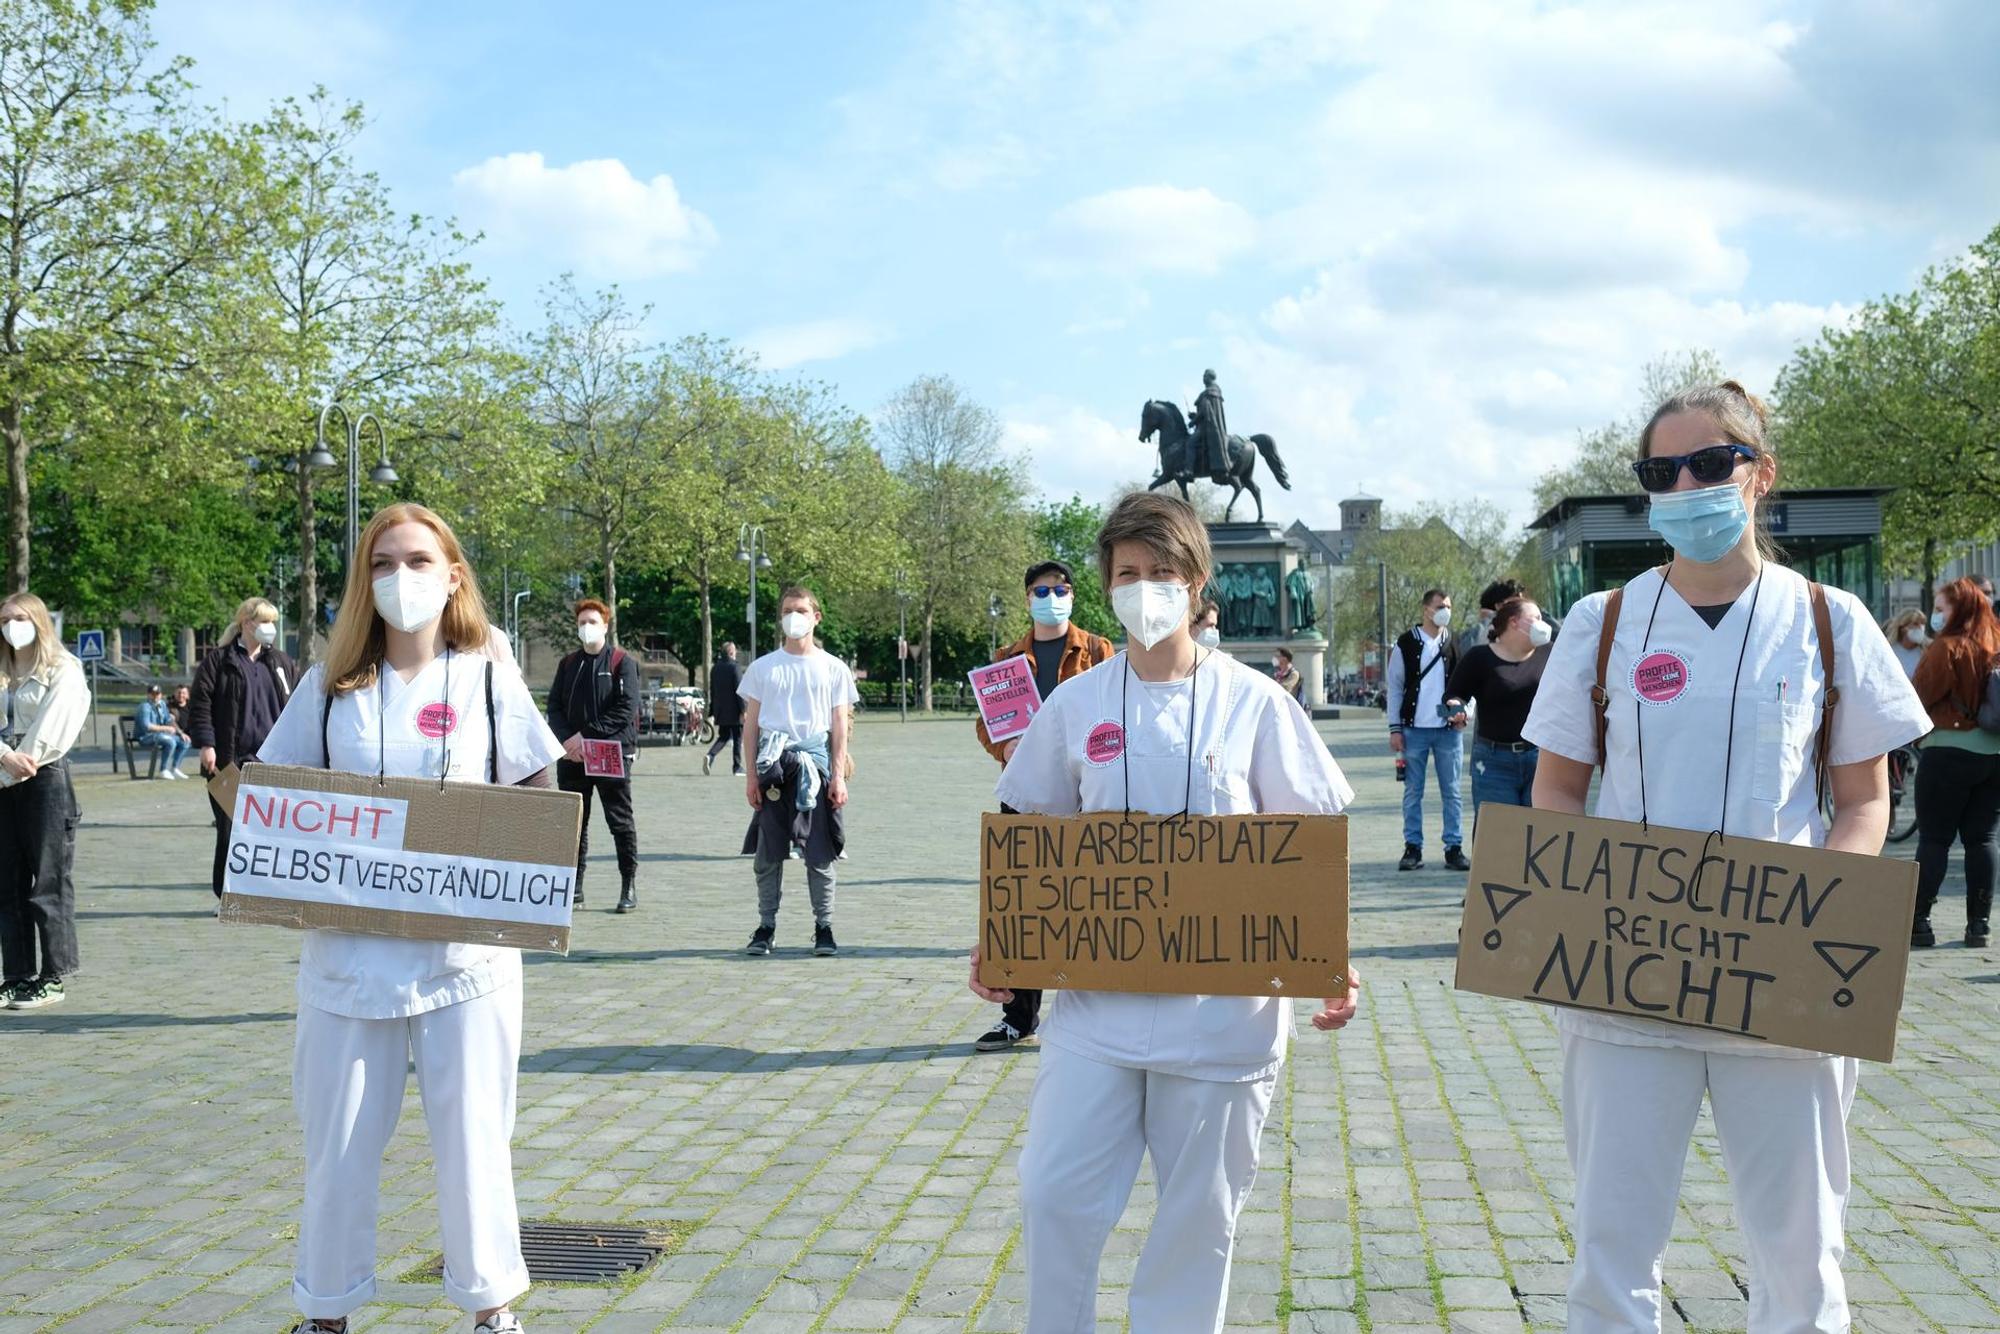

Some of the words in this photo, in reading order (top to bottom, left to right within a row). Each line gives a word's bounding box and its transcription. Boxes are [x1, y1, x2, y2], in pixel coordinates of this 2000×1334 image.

[984, 665, 1017, 684] JETZT
[1638, 661, 1680, 679] PROFITE
[1090, 730, 1121, 744] PROFITE
[242, 794, 393, 840] NICHT
[985, 825, 1064, 870] MEIN
[1074, 820, 1303, 867] ARBEITSPLATZ
[228, 842, 571, 908] SELBSTVERSTÄNDLICH
[987, 875, 1028, 912] IST
[1036, 871, 1170, 911] SICHER!
[1523, 825, 1842, 928] KLATSCHEN
[986, 915, 1145, 961] NIEMAND
[1157, 915, 1231, 963] WILL
[1242, 914, 1328, 963] IHN...
[1604, 906, 1750, 963] REICHT
[1532, 932, 1777, 1032] NICHT
